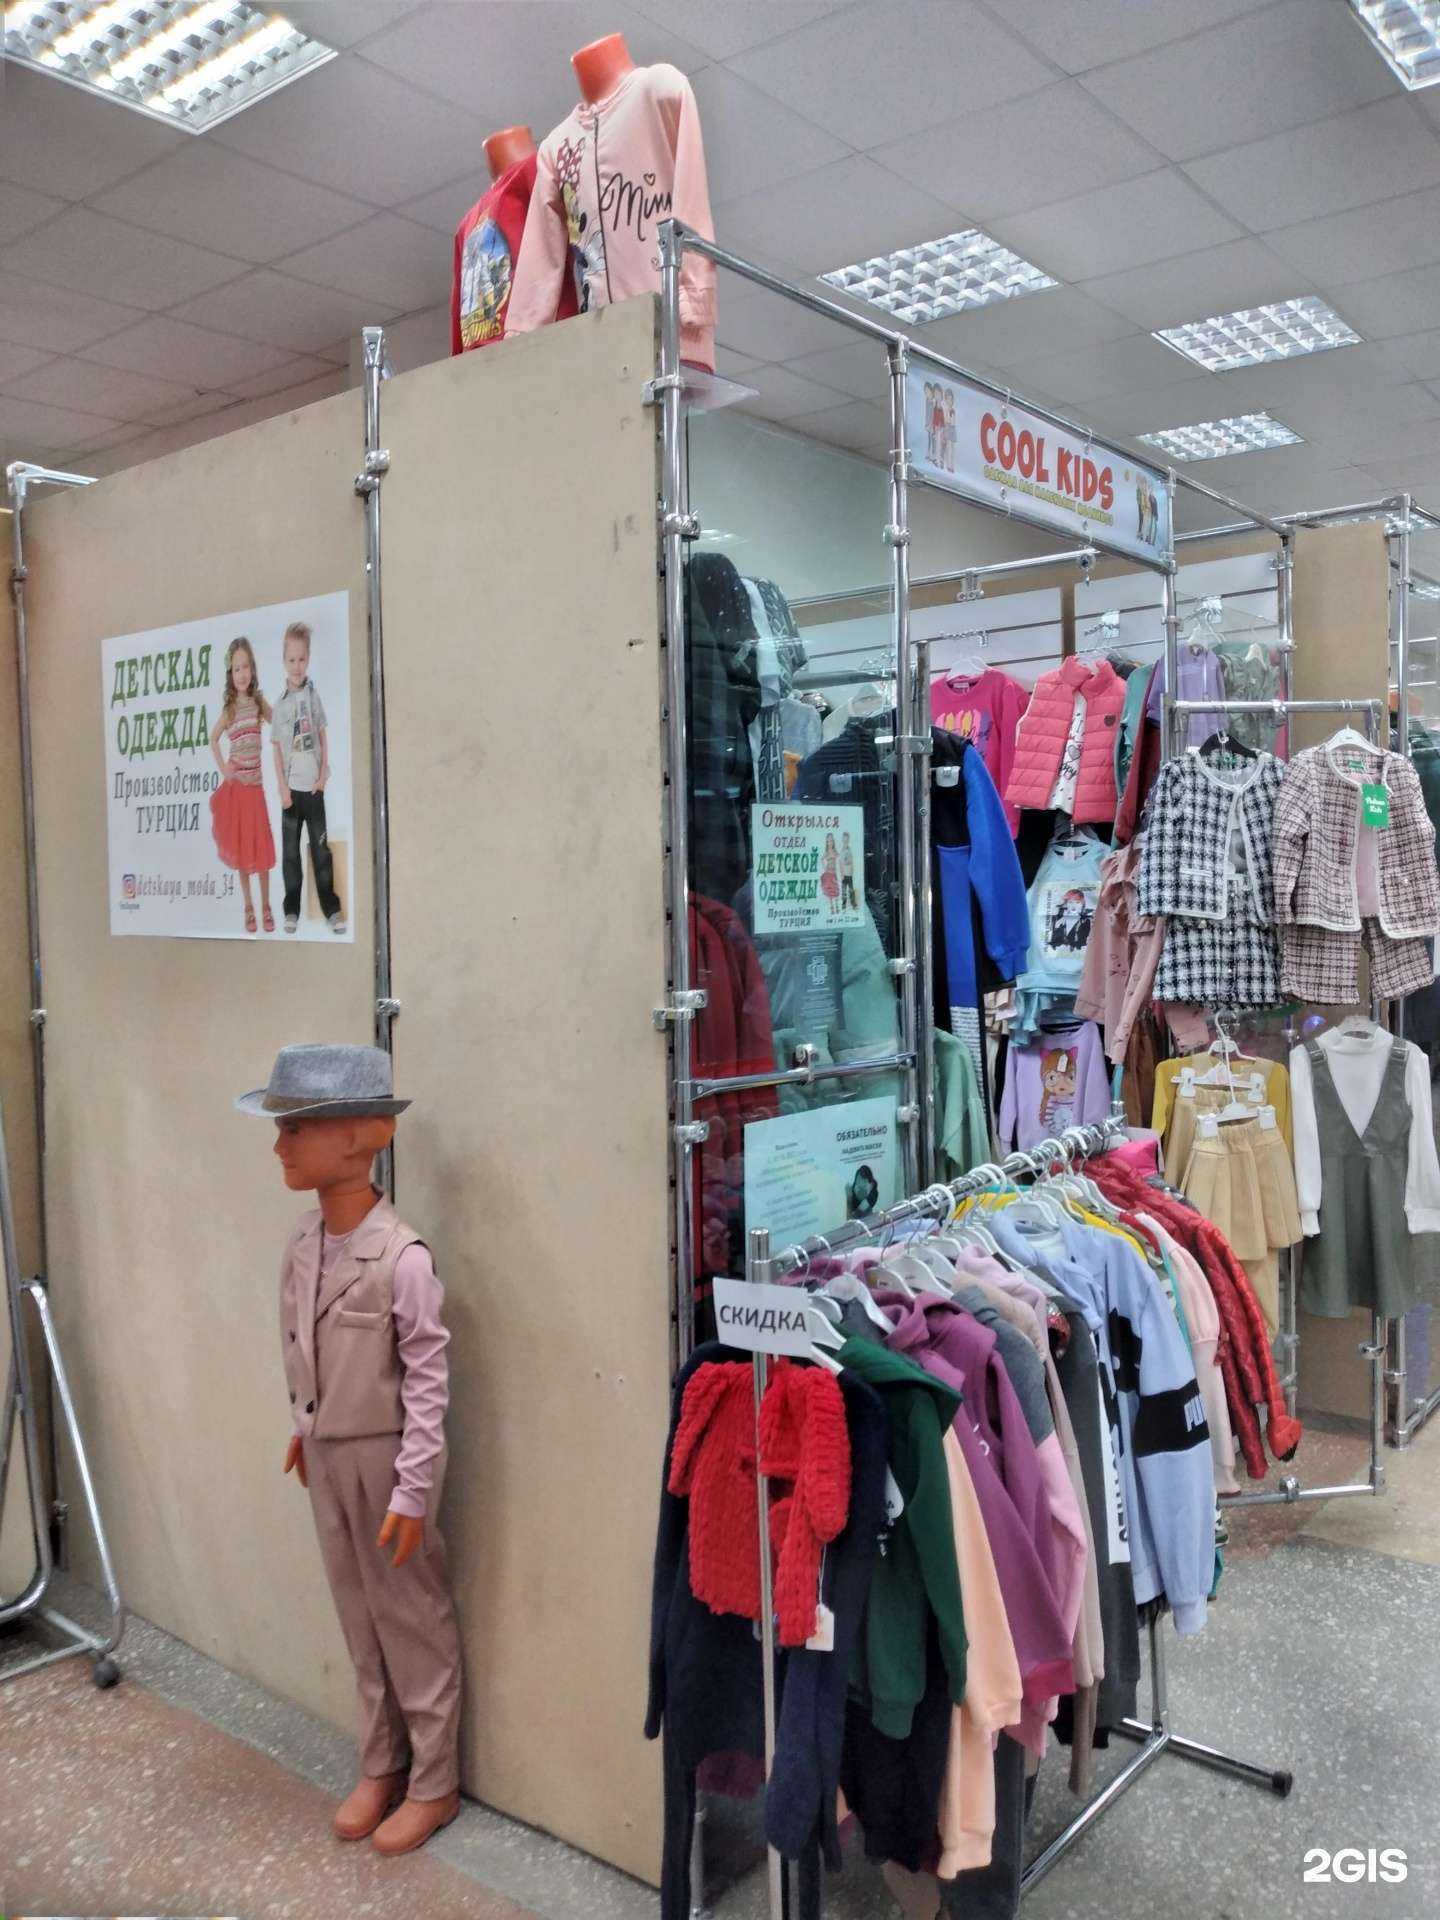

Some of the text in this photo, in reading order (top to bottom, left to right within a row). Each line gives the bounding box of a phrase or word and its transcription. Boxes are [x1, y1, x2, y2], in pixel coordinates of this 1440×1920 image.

[980, 412, 1049, 483] COOL
[1057, 447, 1114, 510] KIDS
[111, 644, 212, 709] ДЕТСКАЯ
[117, 705, 209, 761] ОДЕЖДА
[113, 767, 219, 807] Производство
[136, 803, 200, 839] ТУРЦИЯ
[762, 810, 840, 833] Открылся
[774, 836, 807, 848] ОТДЕЛ
[757, 846, 819, 877] ДЕТСКОЙ
[759, 879, 819, 904] ОДЕЖДЫ
[779, 917, 812, 928] ТУРЦИЯ
[836, 1125, 888, 1142] ОБЯЗАТЕЛЬНО
[720, 1305, 807, 1335] СКИДКА
